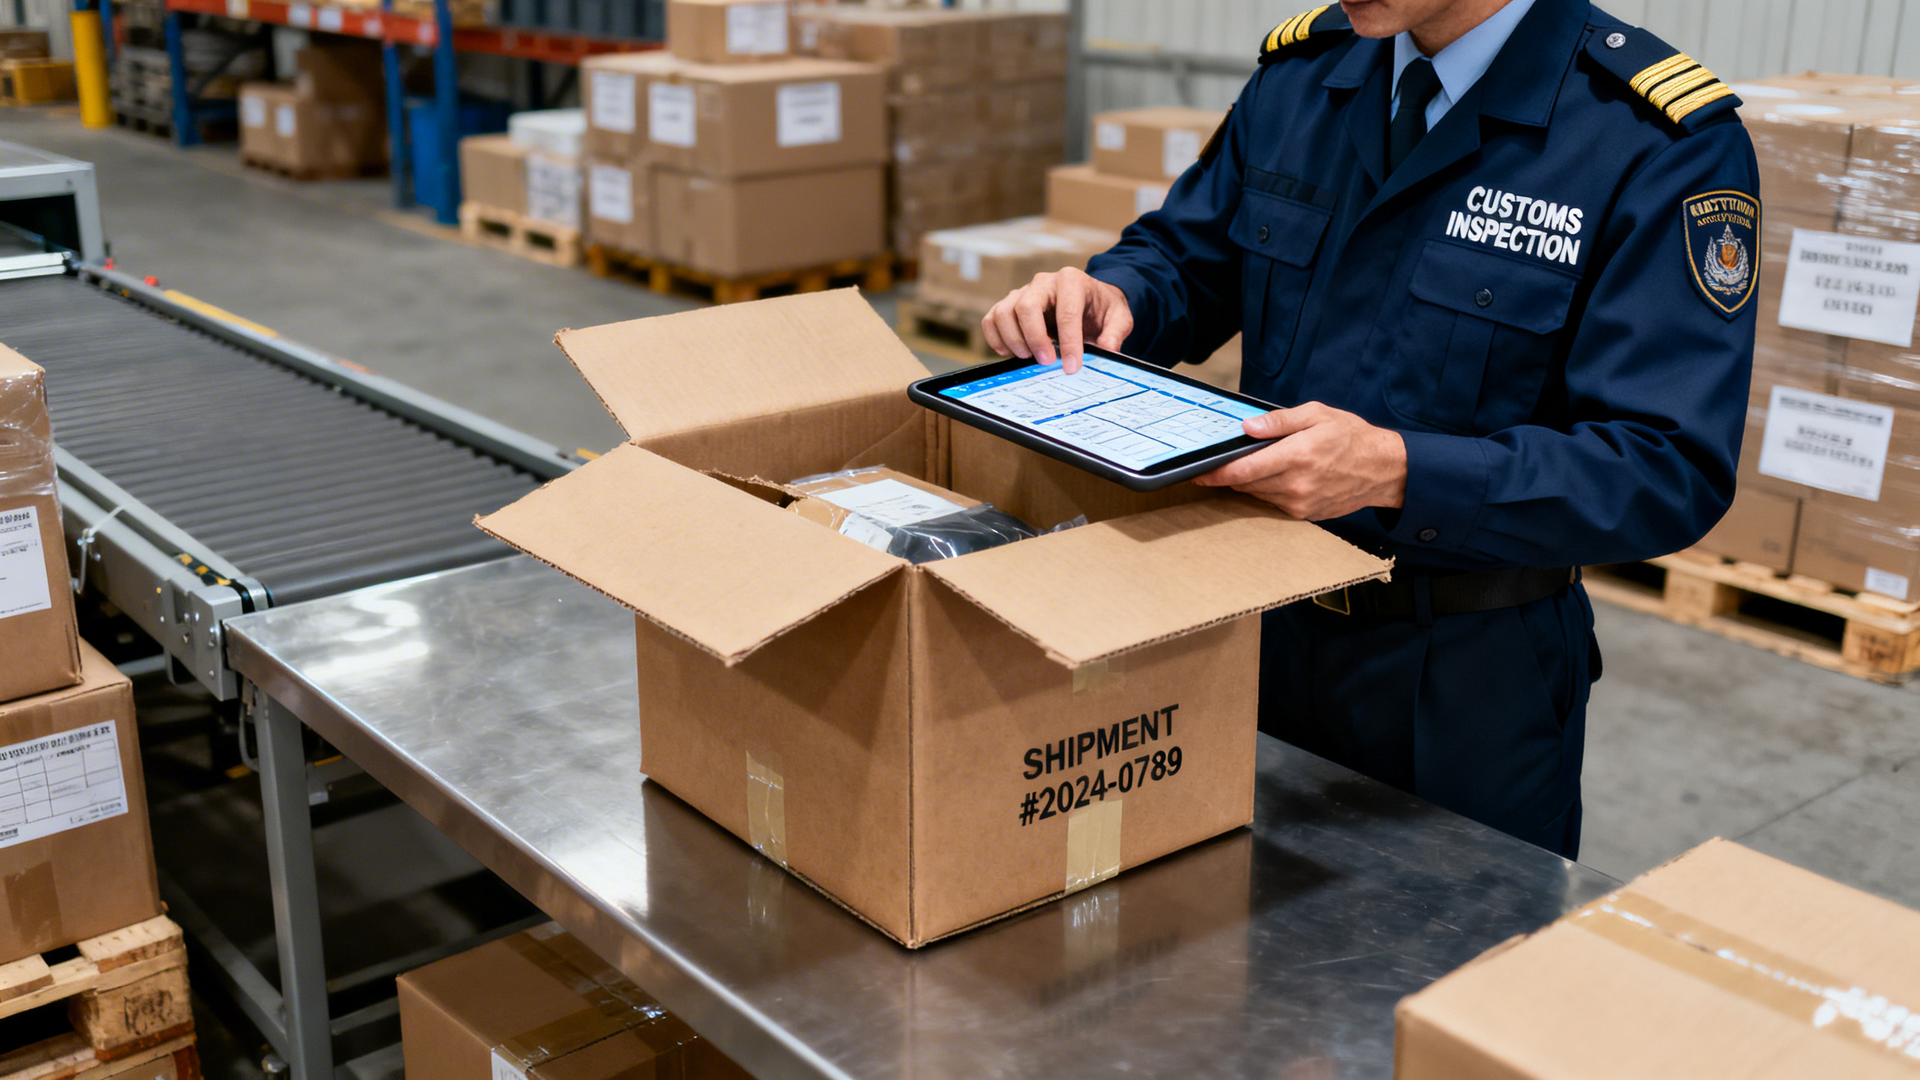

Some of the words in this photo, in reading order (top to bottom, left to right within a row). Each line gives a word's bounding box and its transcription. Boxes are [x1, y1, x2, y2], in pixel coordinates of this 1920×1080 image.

[1445, 210, 1581, 265] INSPECTION
[1466, 185, 1584, 235] CUSTOMS
[1023, 703, 1179, 780] SHIPMENT
[1019, 746, 1183, 827] #2024-0789
